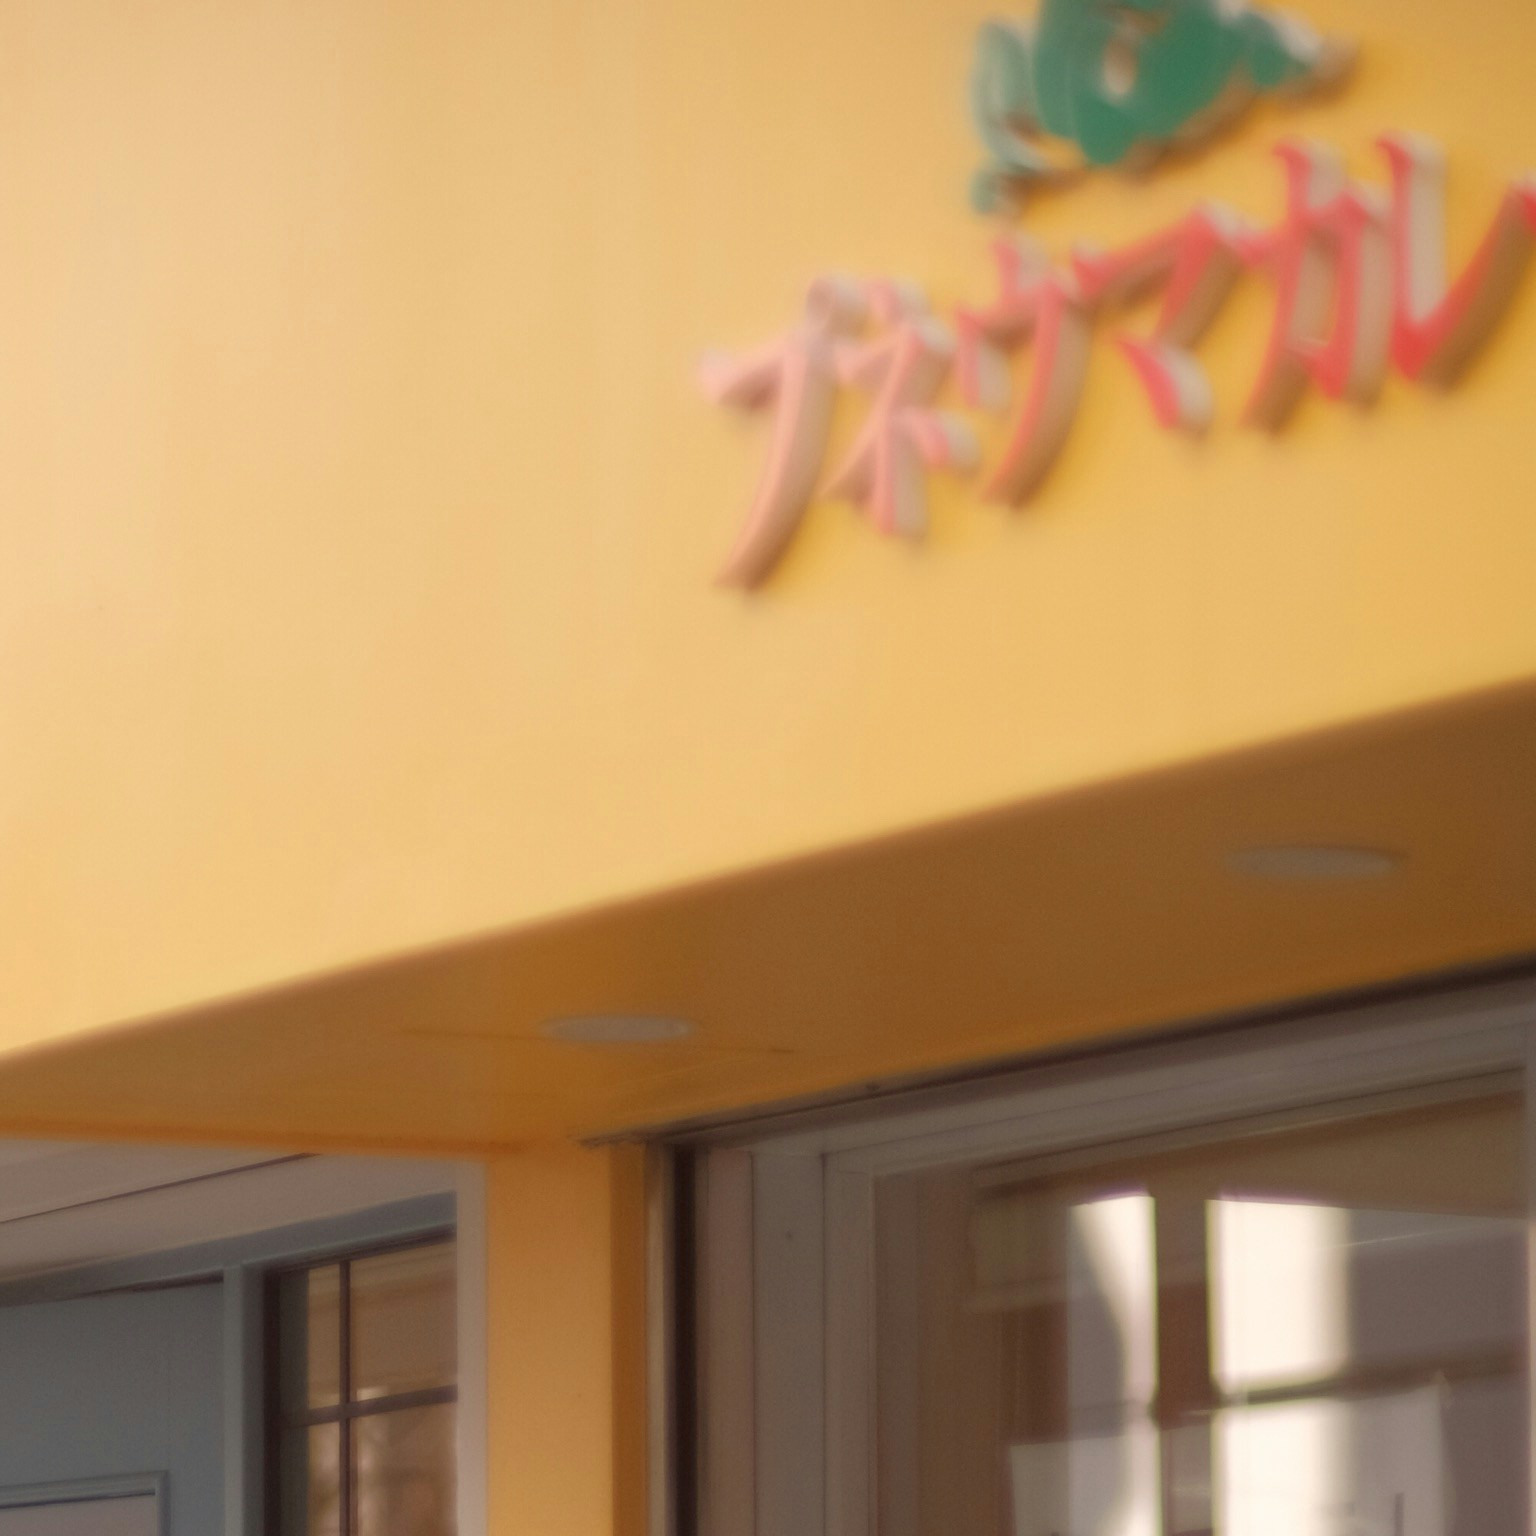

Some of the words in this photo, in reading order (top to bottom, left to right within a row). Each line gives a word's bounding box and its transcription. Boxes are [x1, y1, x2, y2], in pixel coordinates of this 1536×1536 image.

[696, 128, 1536, 592] プネウマカレ
